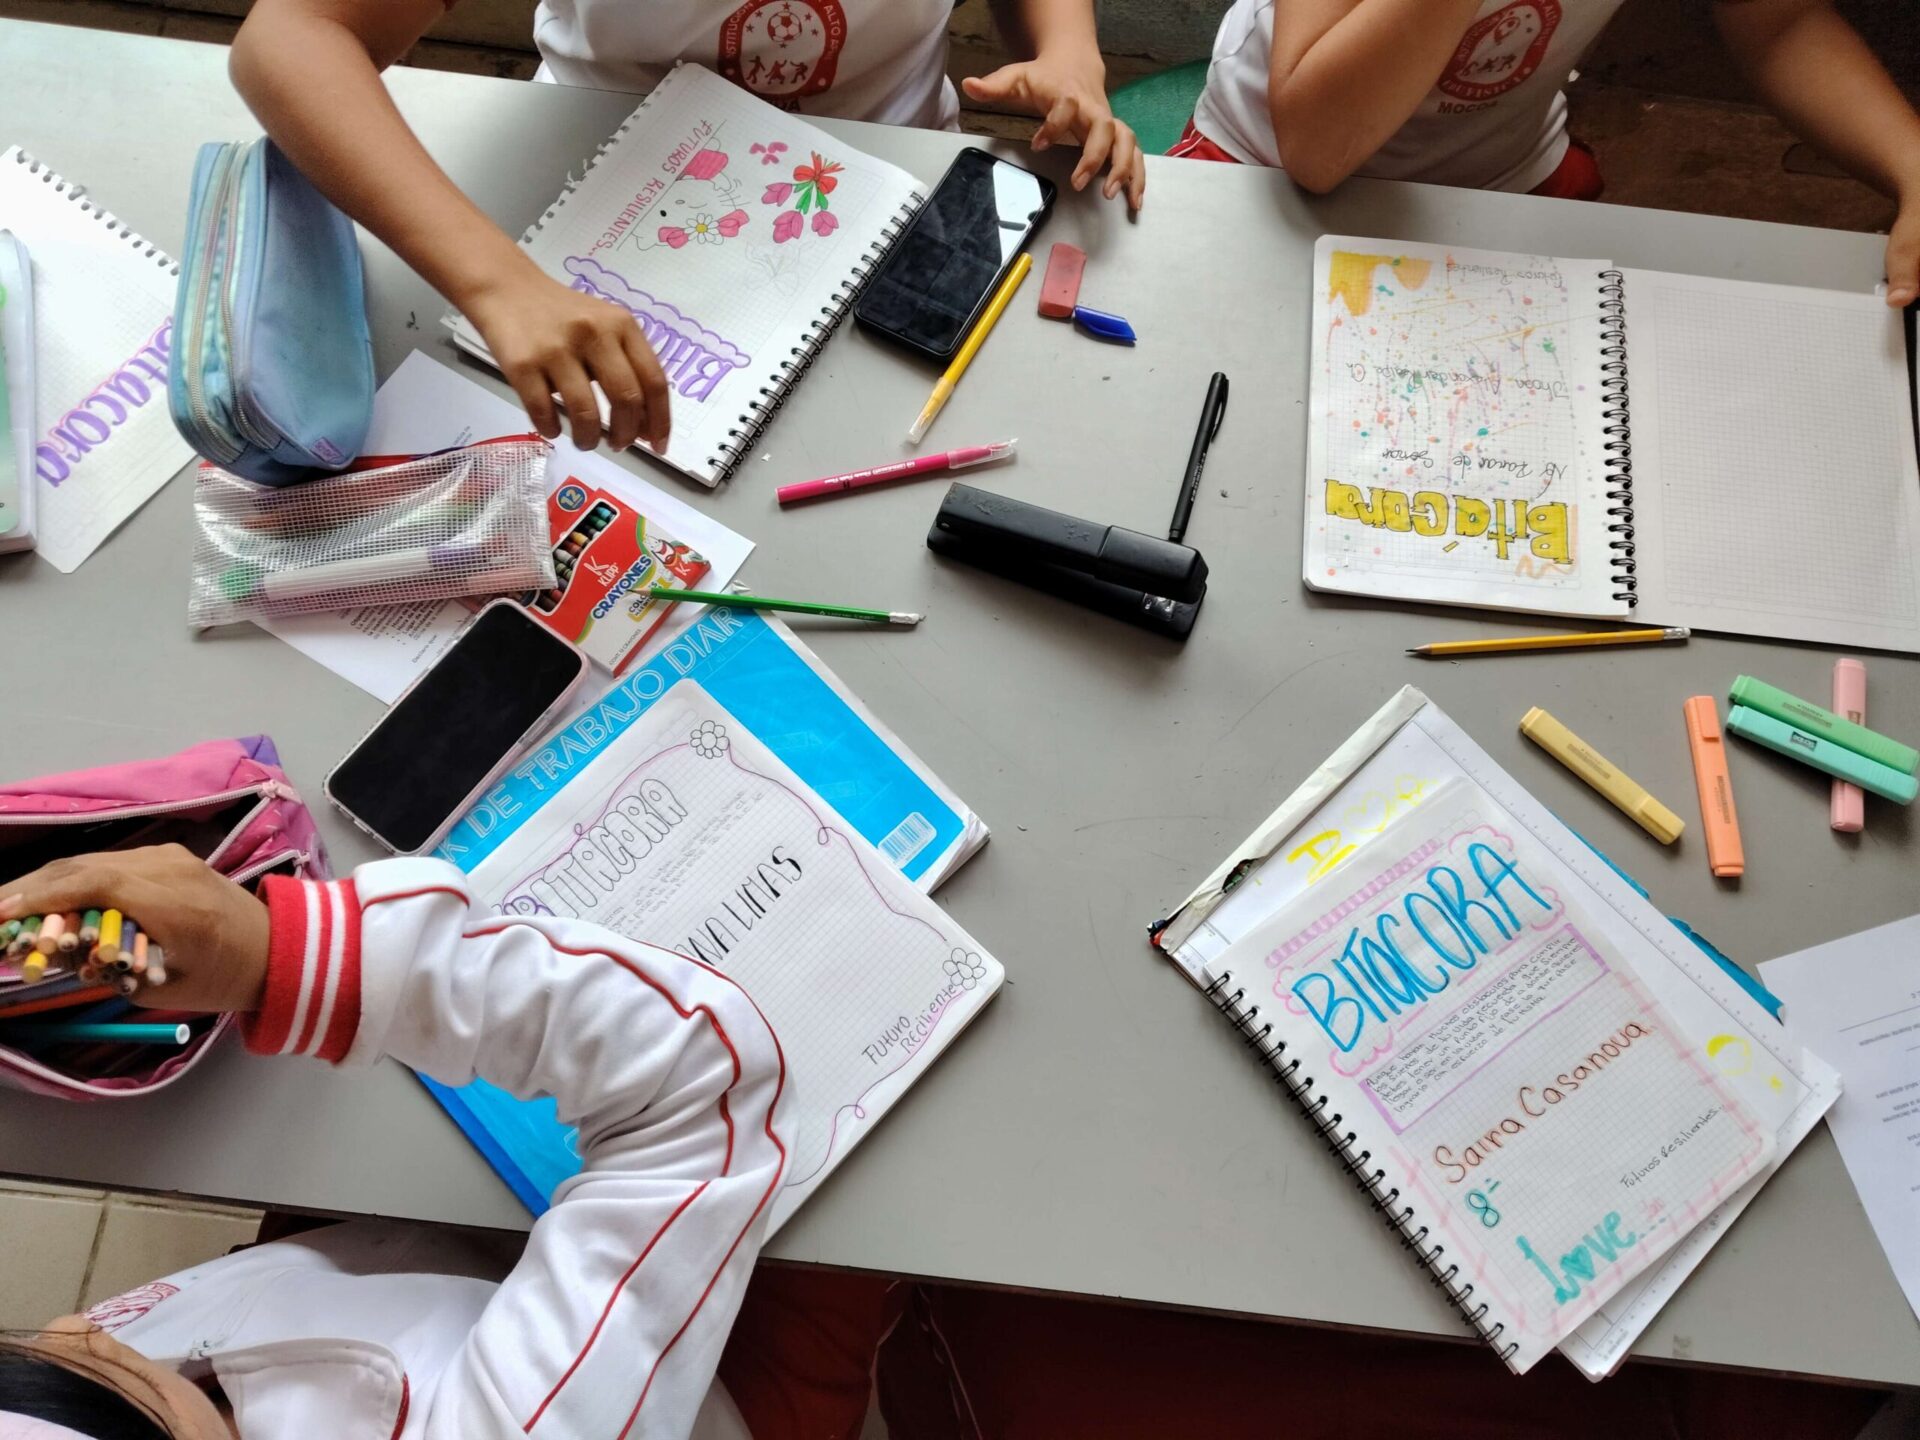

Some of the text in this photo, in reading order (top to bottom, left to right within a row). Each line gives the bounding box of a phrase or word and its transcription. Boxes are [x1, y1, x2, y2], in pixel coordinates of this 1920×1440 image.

[661, 119, 713, 174] FUTUROS
[1449, 454, 1471, 479] de
[559, 487, 581, 508] 12
[592, 555, 652, 620] CRAYONES
[464, 791, 515, 839] DE
[517, 673, 665, 790] TRABAJO
[502, 777, 689, 921] BITACORA
[1424, 1043, 1439, 1055] de
[1521, 965, 1540, 980] que
[1439, 1045, 1451, 1057] un
[1440, 1056, 1452, 1067] en
[1432, 1019, 1655, 1187] Saira Casanova
